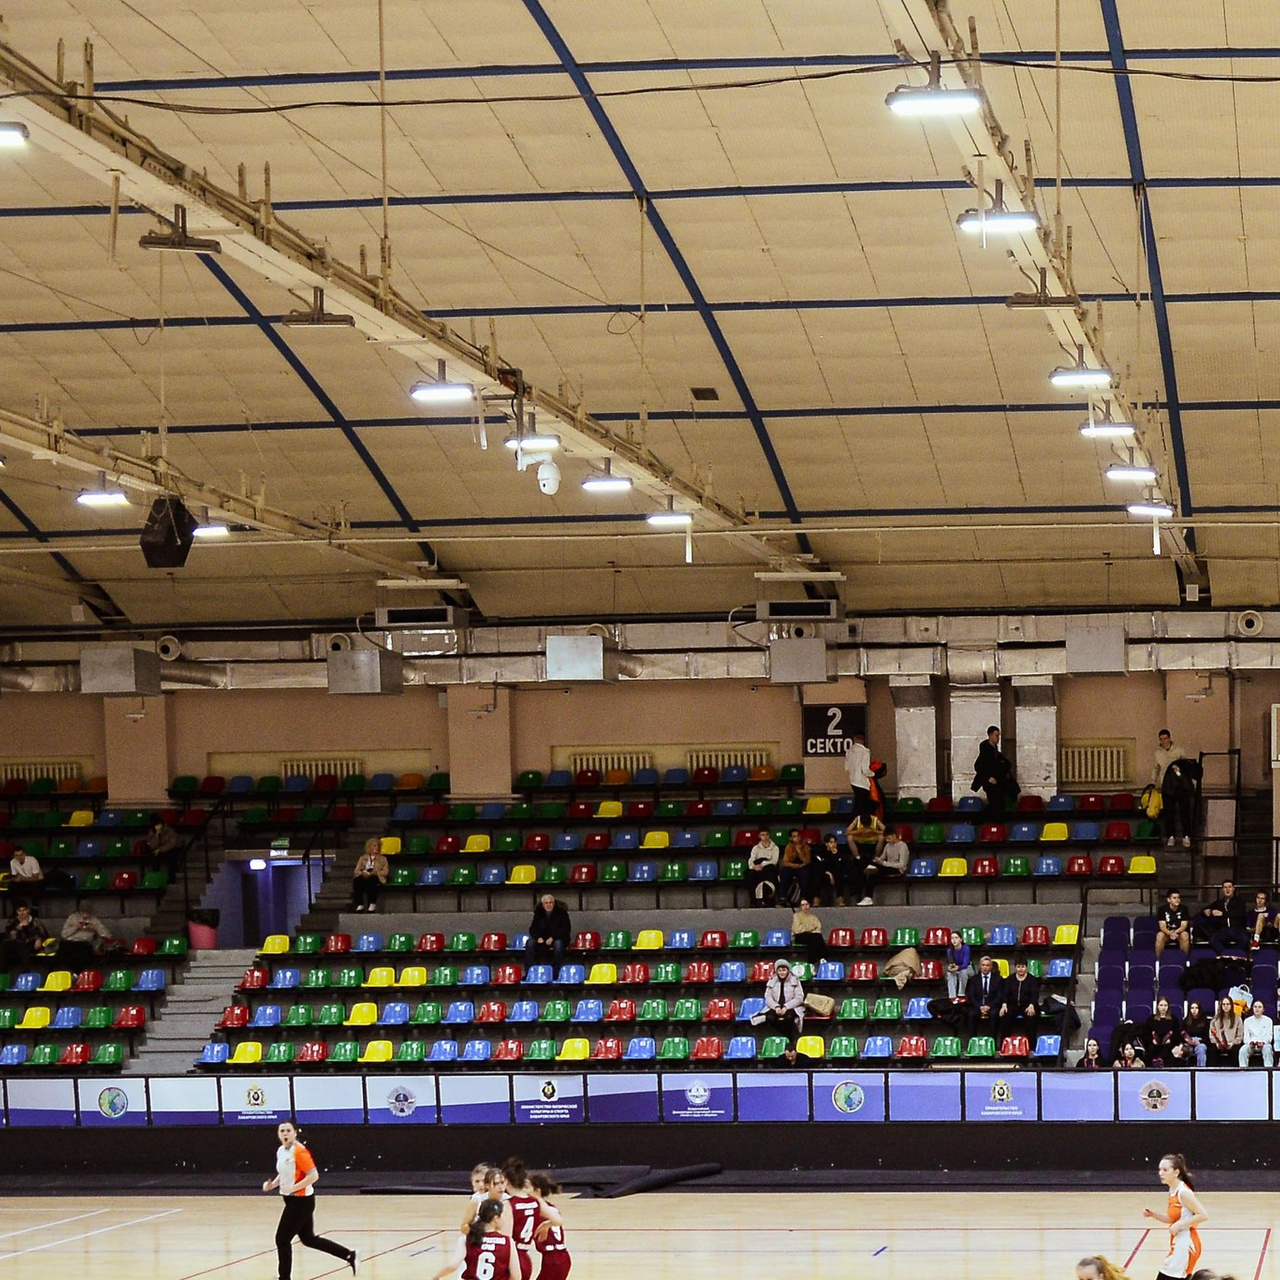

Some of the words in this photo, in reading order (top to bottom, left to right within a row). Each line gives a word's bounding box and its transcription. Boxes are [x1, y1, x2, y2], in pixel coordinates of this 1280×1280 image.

[827, 707, 843, 736] 2
[806, 738, 853, 753] СЕКТО
[520, 1216, 534, 1242] 4
[476, 1251, 495, 1280] 6
